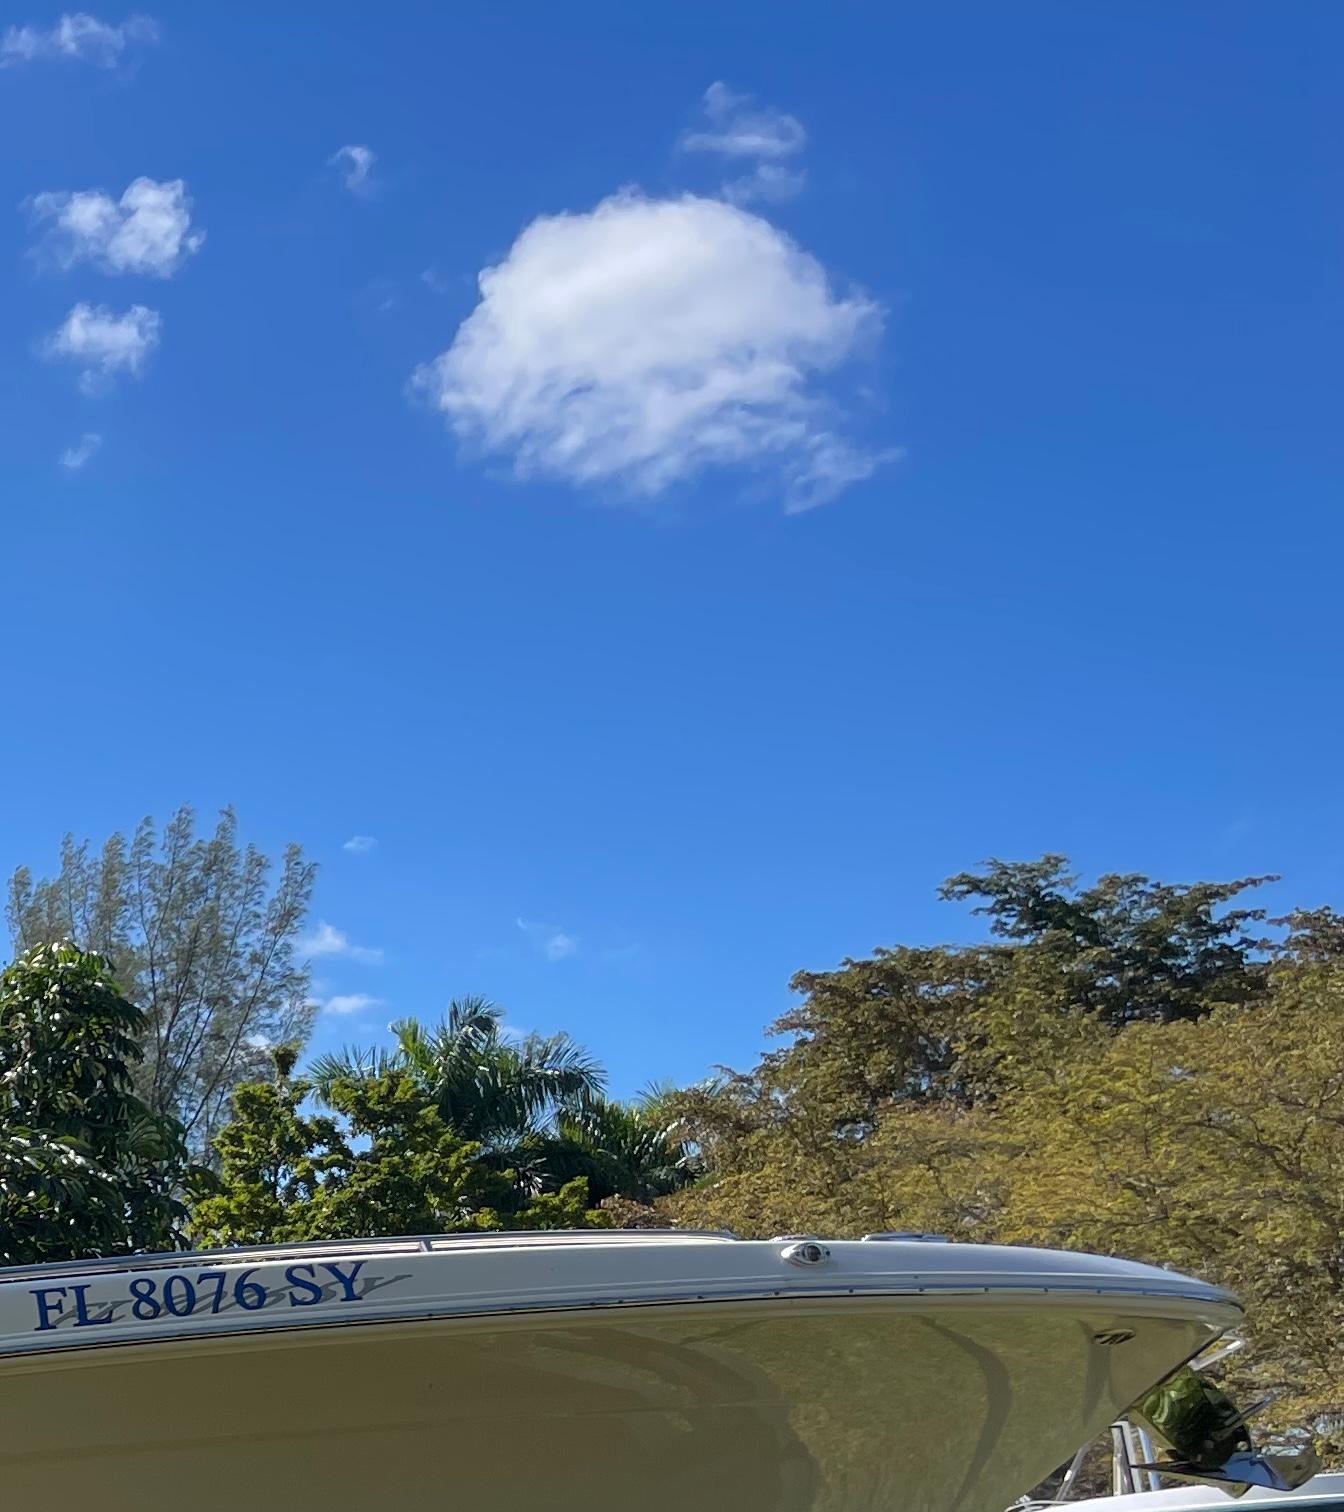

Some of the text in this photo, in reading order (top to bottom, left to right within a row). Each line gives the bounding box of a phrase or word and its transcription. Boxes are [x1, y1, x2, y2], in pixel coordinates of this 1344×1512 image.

[29, 1259, 369, 1331] FL 8076 SY
